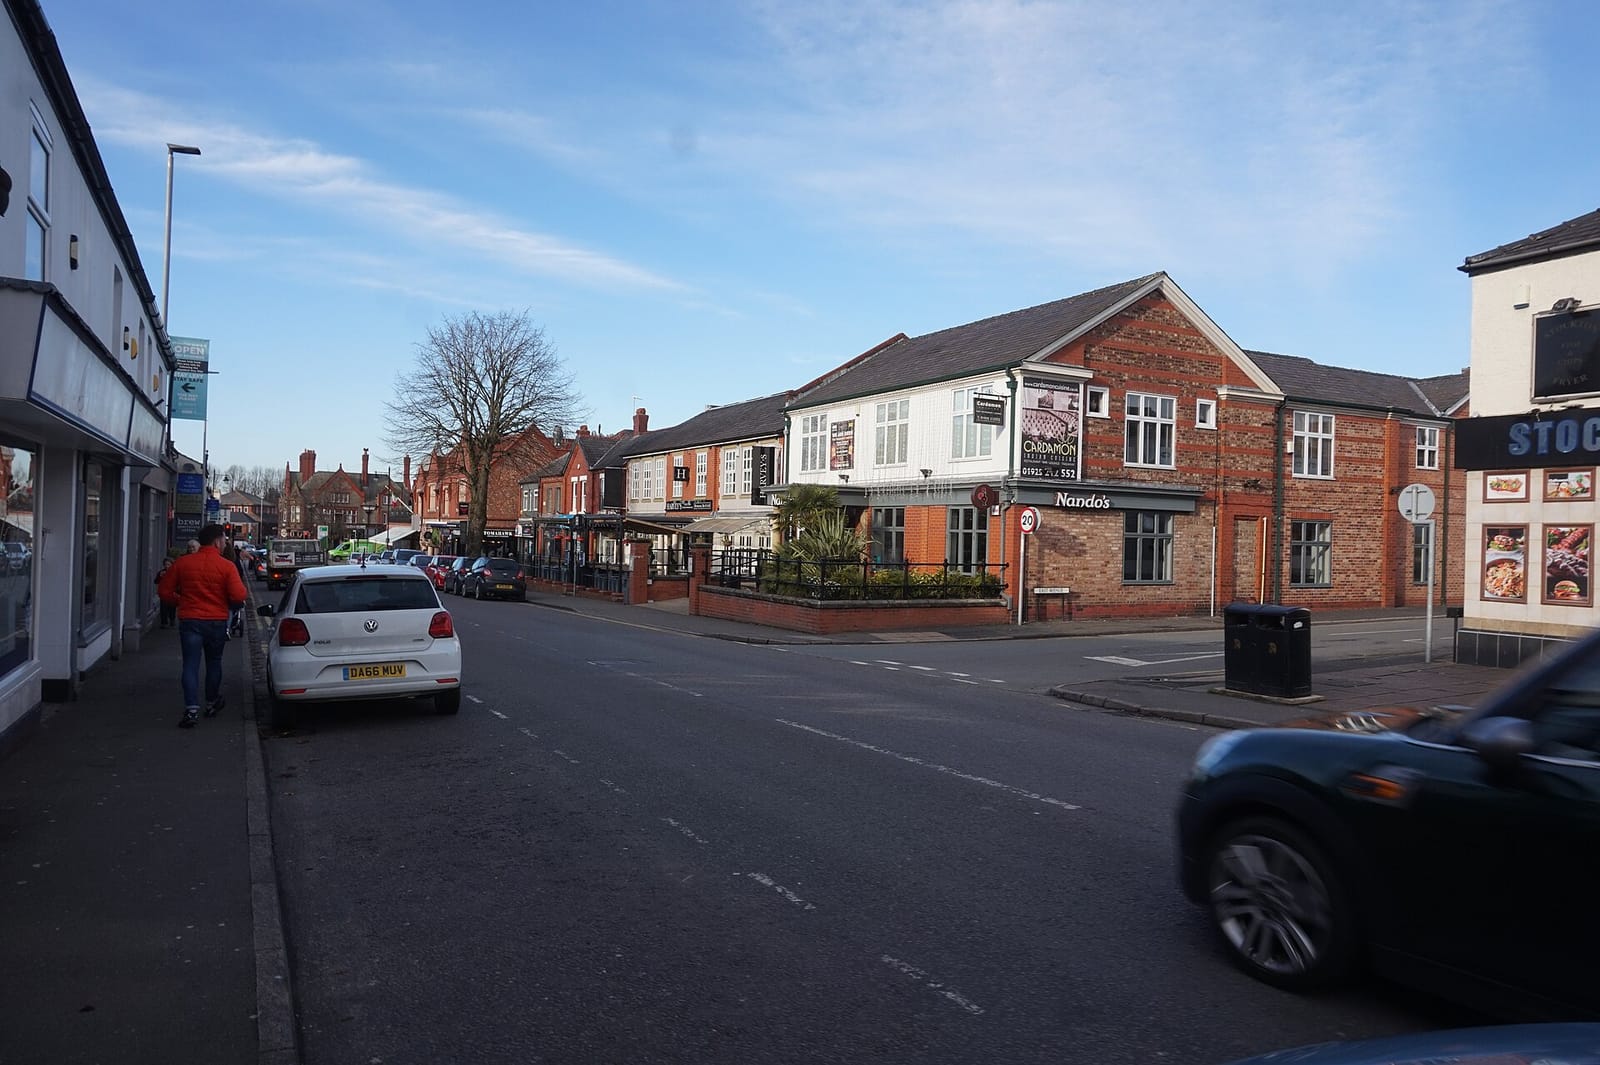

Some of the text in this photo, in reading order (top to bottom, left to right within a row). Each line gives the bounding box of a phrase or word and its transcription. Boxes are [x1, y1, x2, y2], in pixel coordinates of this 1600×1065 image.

[174, 346, 205, 355] OPEN
[1023, 440, 1077, 456] CARDAMON
[677, 468, 686, 479] H
[1060, 468, 1076, 478] 552
[1056, 492, 1110, 508] Nando's
[177, 517, 201, 525] brew
[1022, 515, 1033, 526] 20
[350, 665, 404, 678] DA66 MUV
